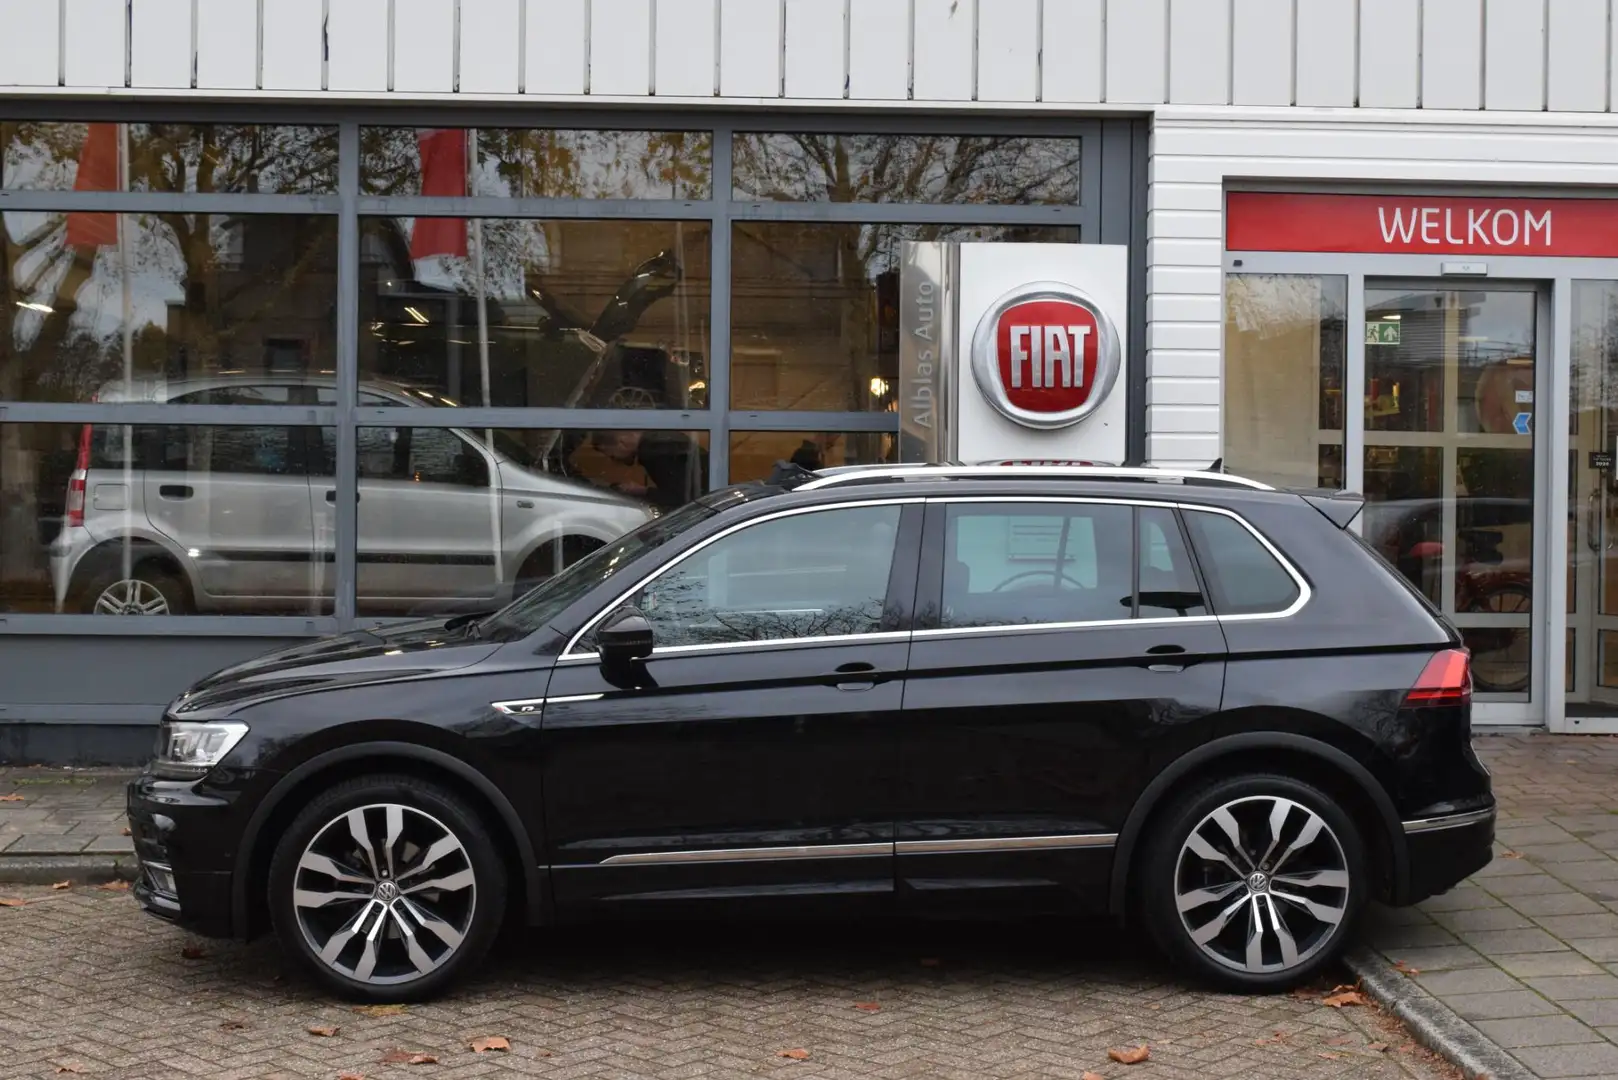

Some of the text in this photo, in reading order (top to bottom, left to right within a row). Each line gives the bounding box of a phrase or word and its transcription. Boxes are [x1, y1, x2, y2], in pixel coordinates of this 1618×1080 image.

[1378, 207, 1552, 246] WELKOM
[910, 281, 935, 429] Alblas Auto
[1009, 325, 1091, 389] FIAT
